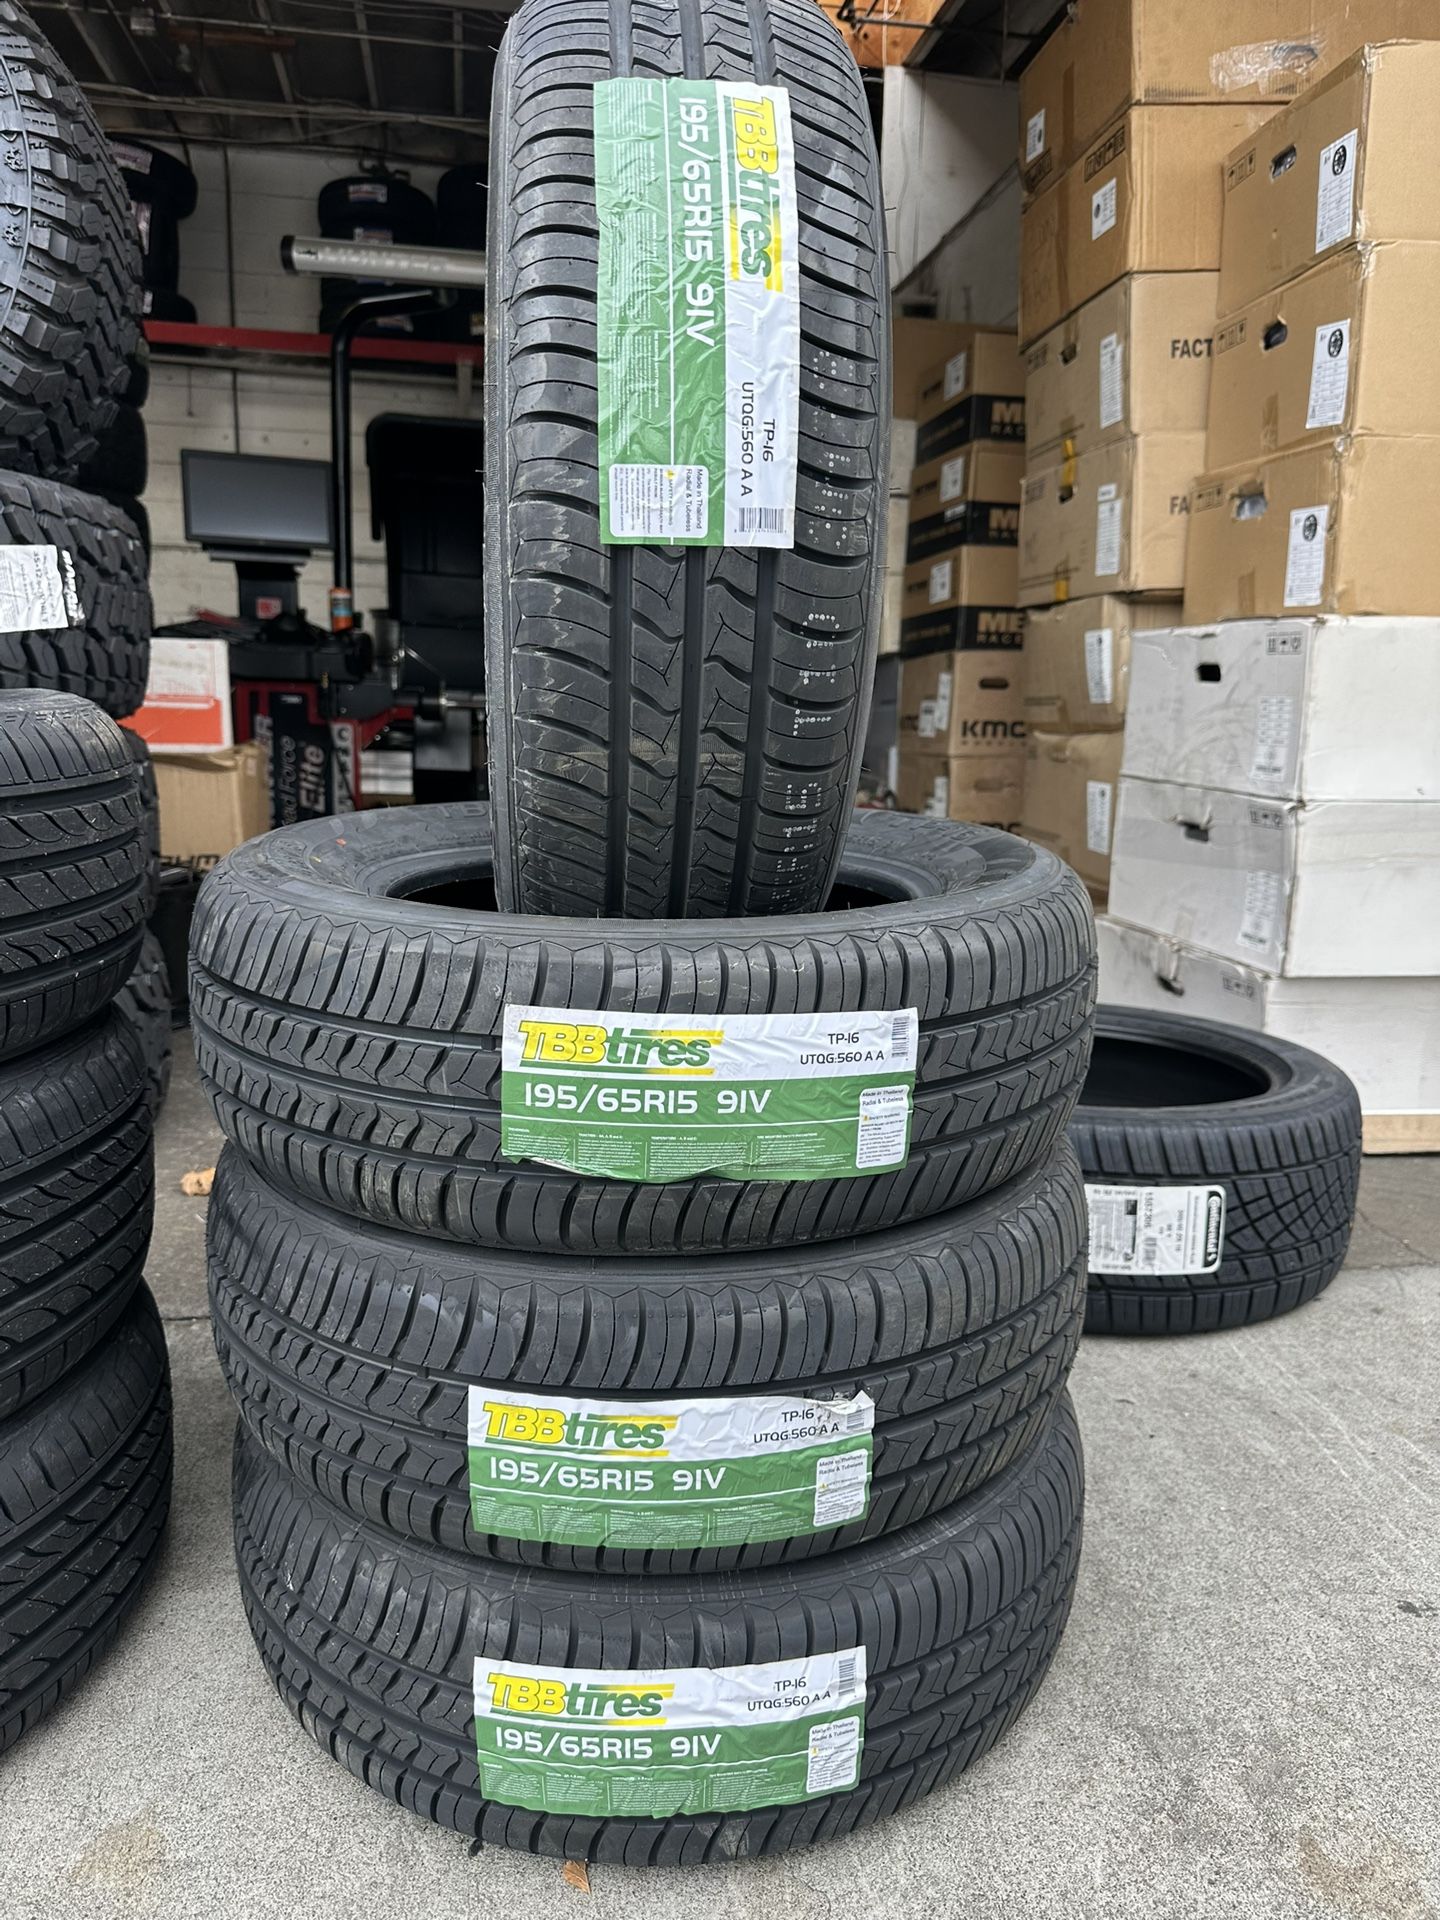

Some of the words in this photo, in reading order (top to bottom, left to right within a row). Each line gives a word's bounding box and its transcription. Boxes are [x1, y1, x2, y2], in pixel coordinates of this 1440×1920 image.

[679, 98, 713, 262] 195/65R15
[732, 97, 779, 278] TBBtires
[686, 283, 714, 347] 91V
[741, 382, 754, 465] UTQG:560
[762, 418, 776, 462] TP-16
[741, 469, 755, 480] A
[741, 485, 753, 497] A
[962, 720, 1026, 738] KMC
[300, 745, 325, 813] Elite
[518, 1020, 712, 1067] TBBtires
[827, 1032, 860, 1046] TP-16
[800, 1051, 862, 1065] UTQG:560
[864, 1051, 873, 1062] A
[876, 1050, 885, 1061] A
[525, 1082, 698, 1114] 195/65R15
[717, 1089, 772, 1114] 91V
[1208, 1196, 1221, 1253] Continental
[482, 1401, 666, 1449] TBBtires
[781, 1408, 815, 1422] TP-16
[753, 1426, 816, 1443] UTQG:560
[819, 1424, 828, 1434] A
[830, 1422, 840, 1432] A
[490, 1456, 654, 1492] 195/65R15
[673, 1467, 726, 1491] 91V
[486, 1672, 664, 1717] TBBtires
[747, 1695, 810, 1711] UTQG:560
[811, 1693, 820, 1703] A
[822, 1690, 831, 1700] A
[774, 1676, 807, 1692] TP-16
[496, 1726, 653, 1759] 195/65R15
[671, 1734, 722, 1758] 91V
